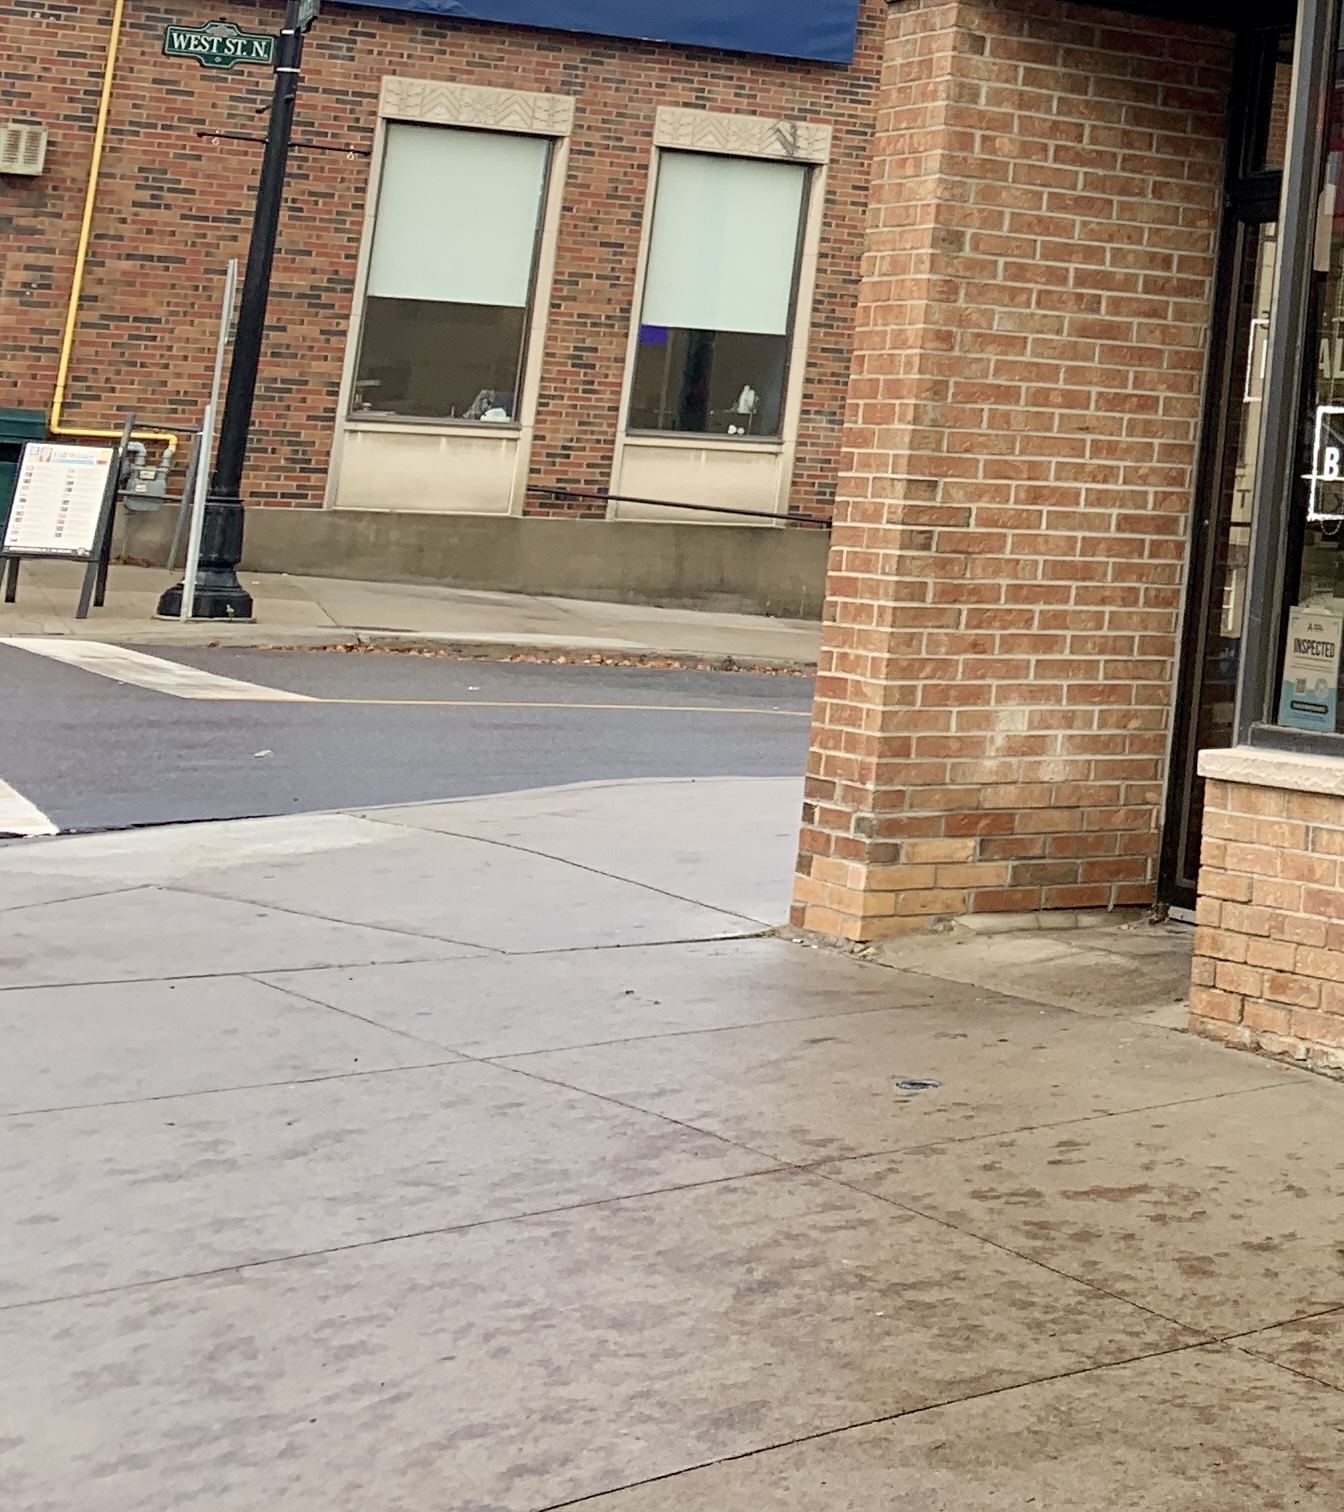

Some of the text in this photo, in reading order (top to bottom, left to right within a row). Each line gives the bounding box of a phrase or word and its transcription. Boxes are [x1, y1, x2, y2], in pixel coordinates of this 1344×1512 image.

[172, 32, 268, 58] WEST ST. N.
[1293, 637, 1336, 659] INSPECTED
